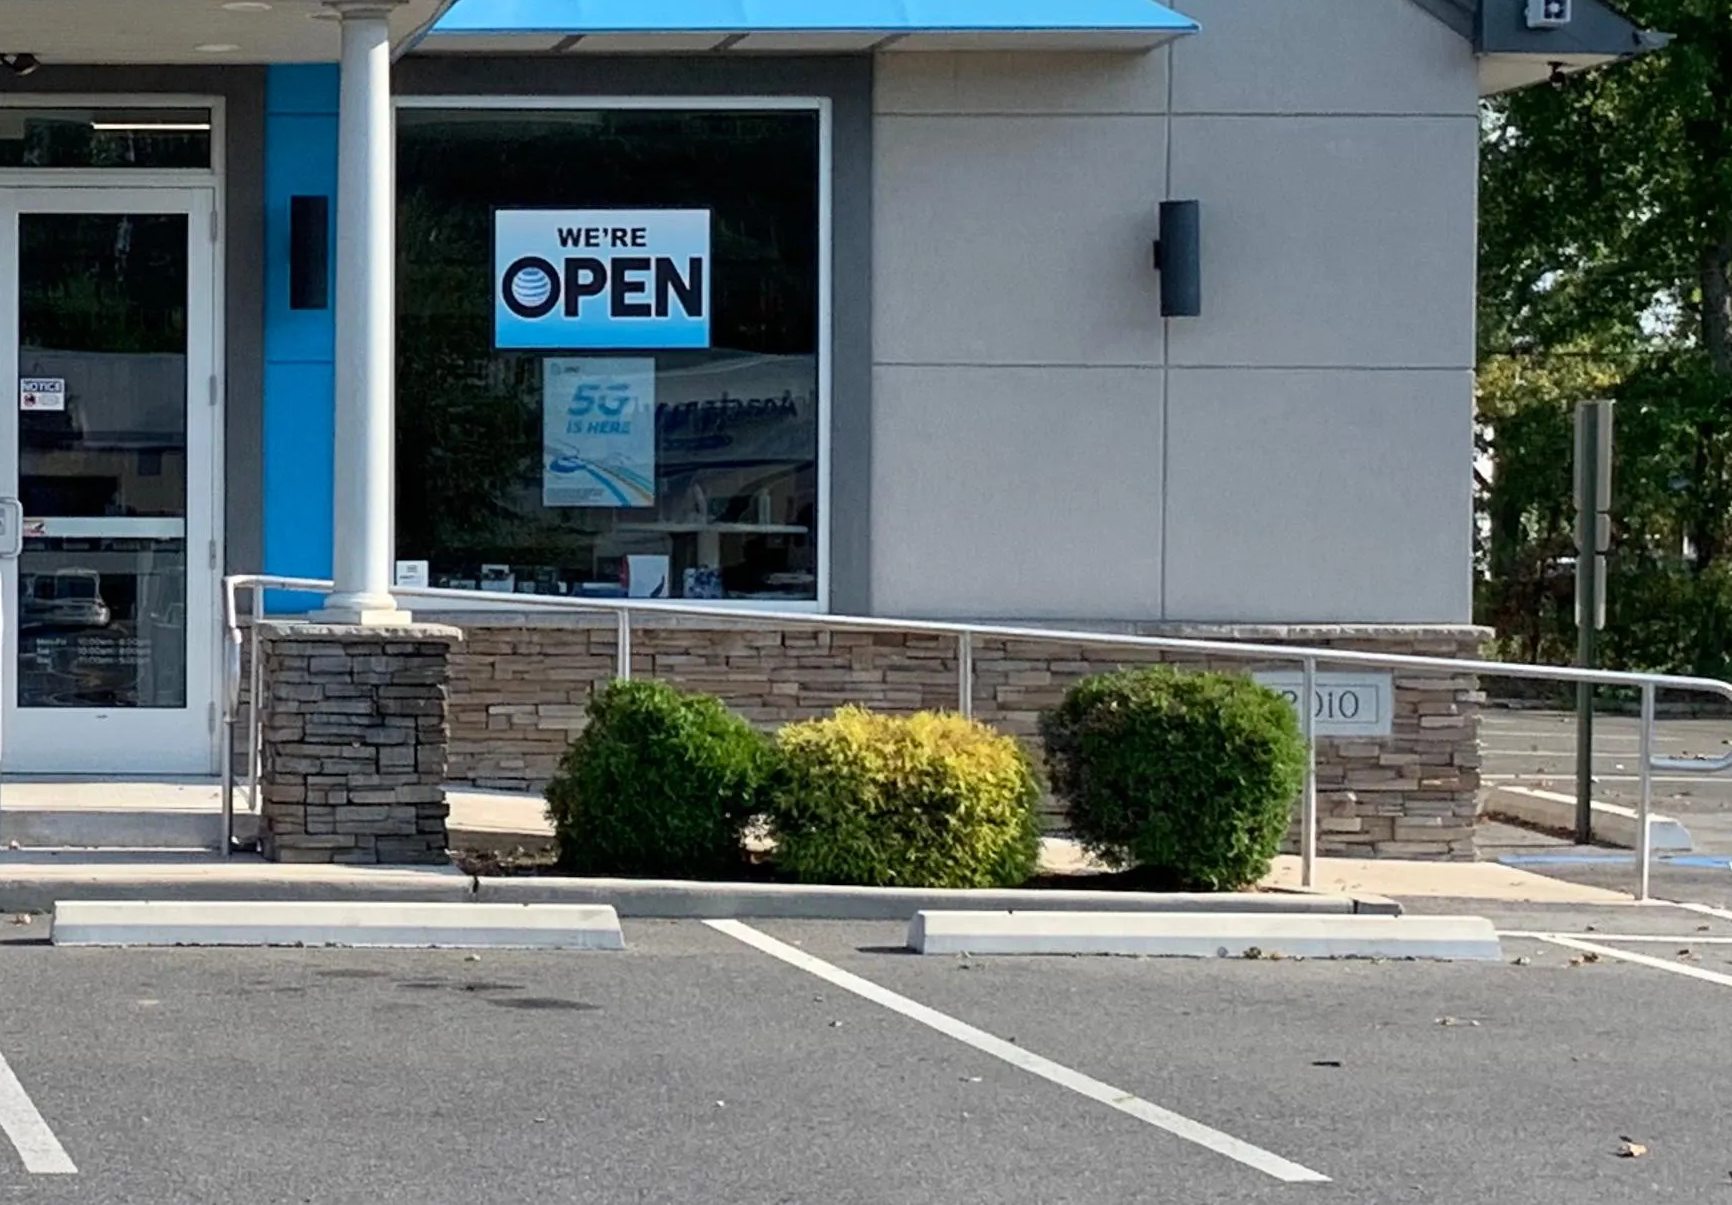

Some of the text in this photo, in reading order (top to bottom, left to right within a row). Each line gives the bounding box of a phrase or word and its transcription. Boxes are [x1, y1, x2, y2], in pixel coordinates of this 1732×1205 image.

[557, 227, 647, 247] WE'RE
[502, 256, 703, 319] OPEN
[567, 383, 631, 417] 5G
[566, 420, 631, 435] IS HERE
